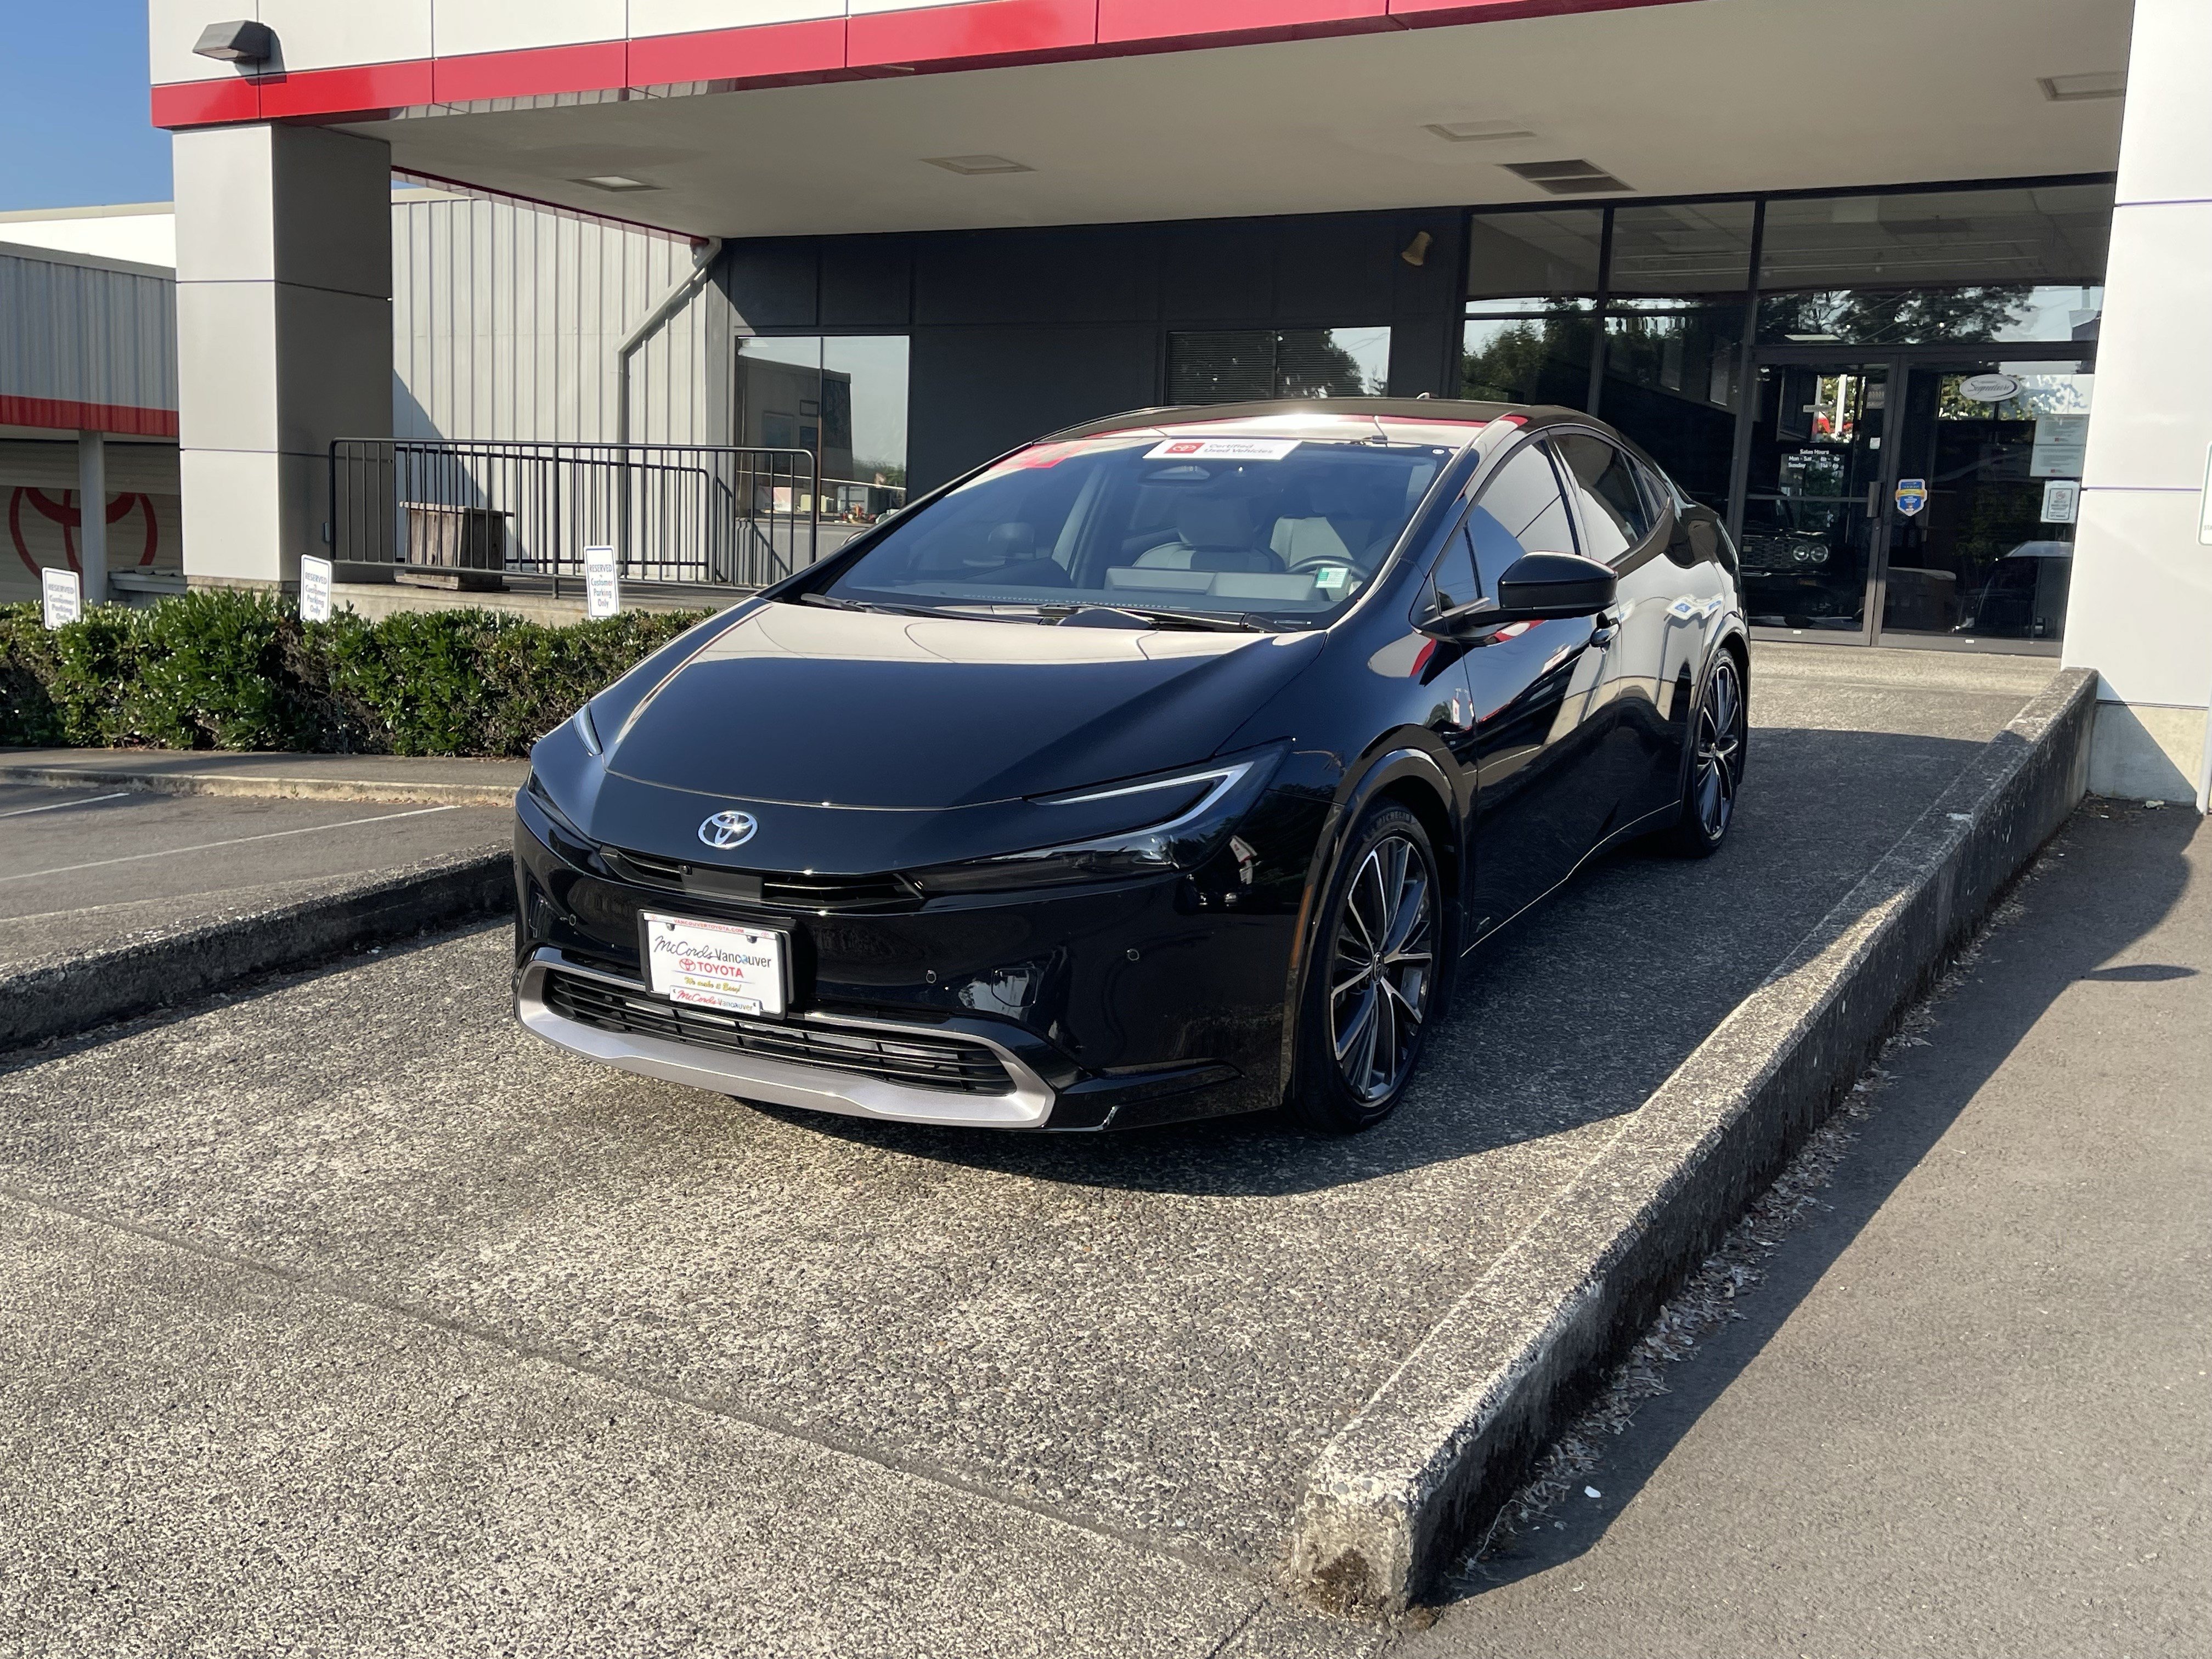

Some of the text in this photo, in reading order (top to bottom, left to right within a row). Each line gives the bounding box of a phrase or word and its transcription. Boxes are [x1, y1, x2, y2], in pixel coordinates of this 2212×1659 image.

[305, 572, 327, 584] RESERVED
[48, 584, 74, 594] RESERVED
[306, 585, 326, 597] Customer
[594, 588, 612, 599] Parking
[307, 594, 324, 608] Parking
[598, 599, 609, 608] Only
[310, 605, 320, 616] Only
[673, 918, 744, 933] VANCOUVERTOYOTA.COM
[697, 962, 744, 978] TOYOTA
